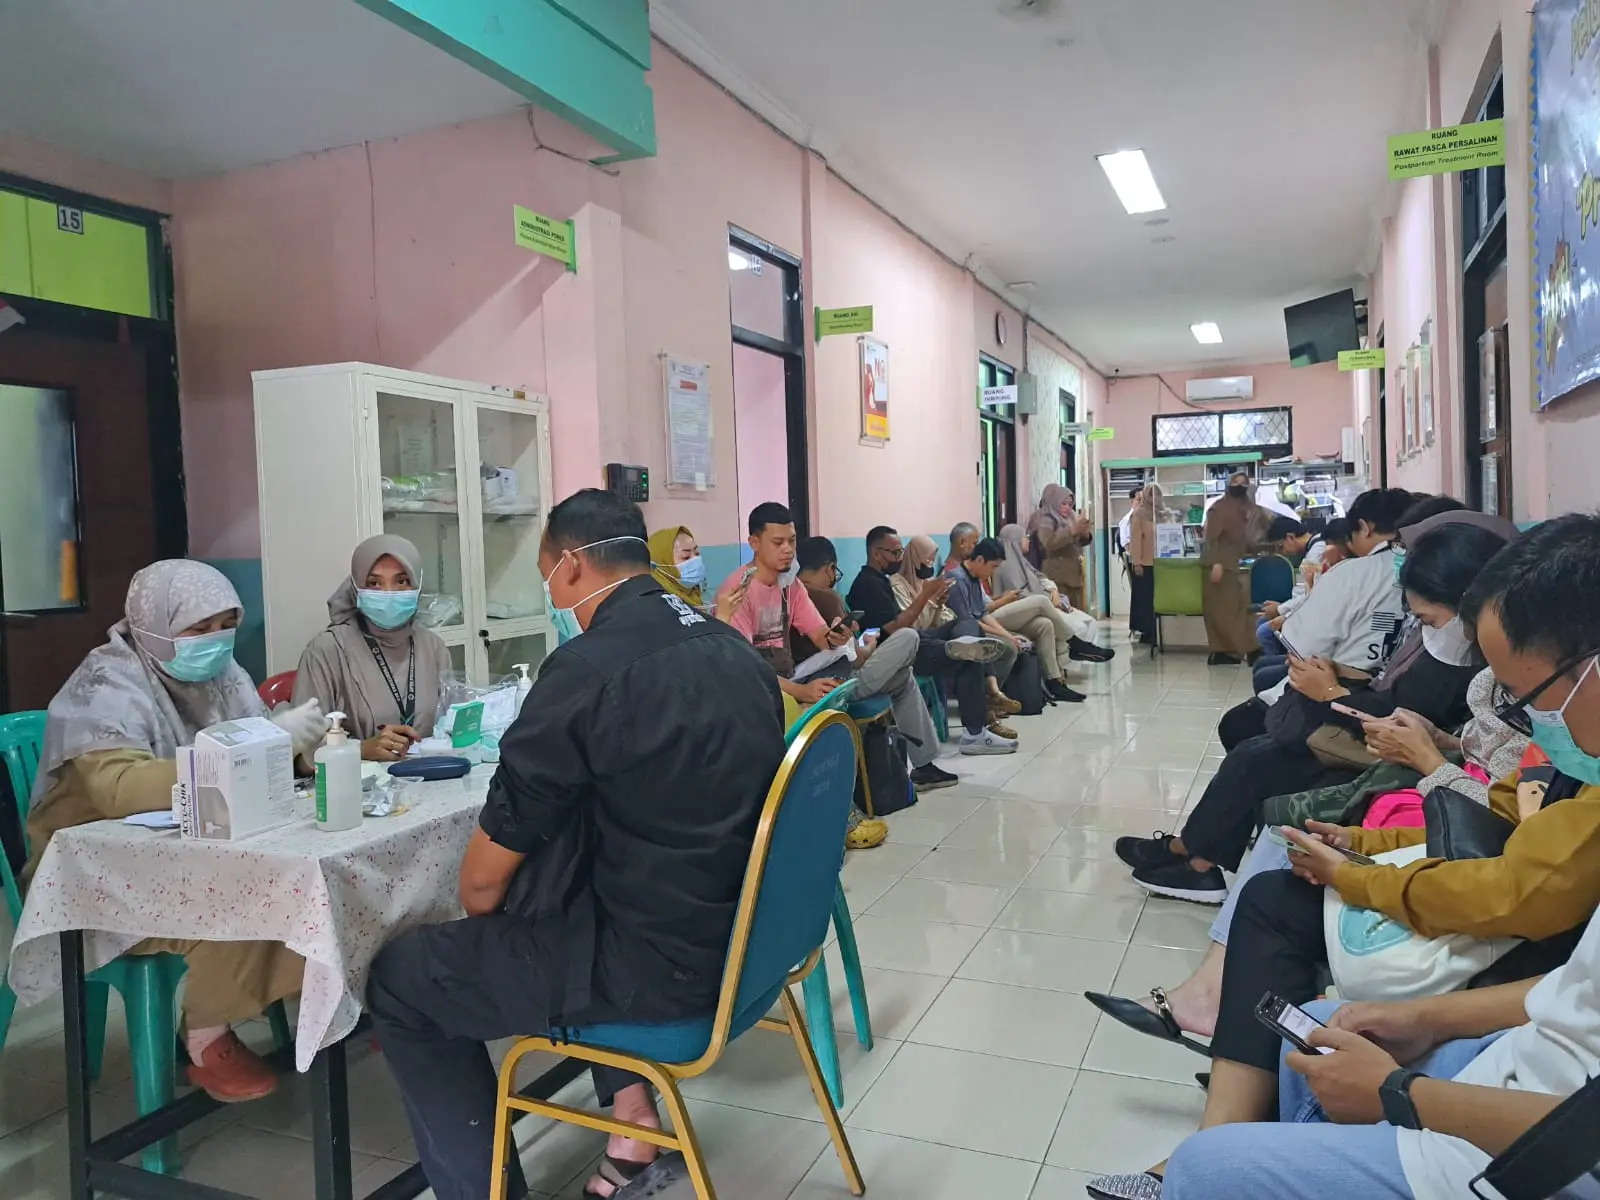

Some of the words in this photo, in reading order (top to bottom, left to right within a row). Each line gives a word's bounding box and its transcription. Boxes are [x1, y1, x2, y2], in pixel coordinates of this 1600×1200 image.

[1431, 129, 1458, 139] RUANG
[1394, 146, 1419, 157] RAWAT
[1422, 143, 1447, 153] PASCA
[1448, 135, 1498, 149] PERSALINAN
[1394, 158, 1436, 170] Postpartum
[1438, 153, 1475, 164] Treatment
[1477, 150, 1499, 159] Room
[60, 209, 80, 230] 15
